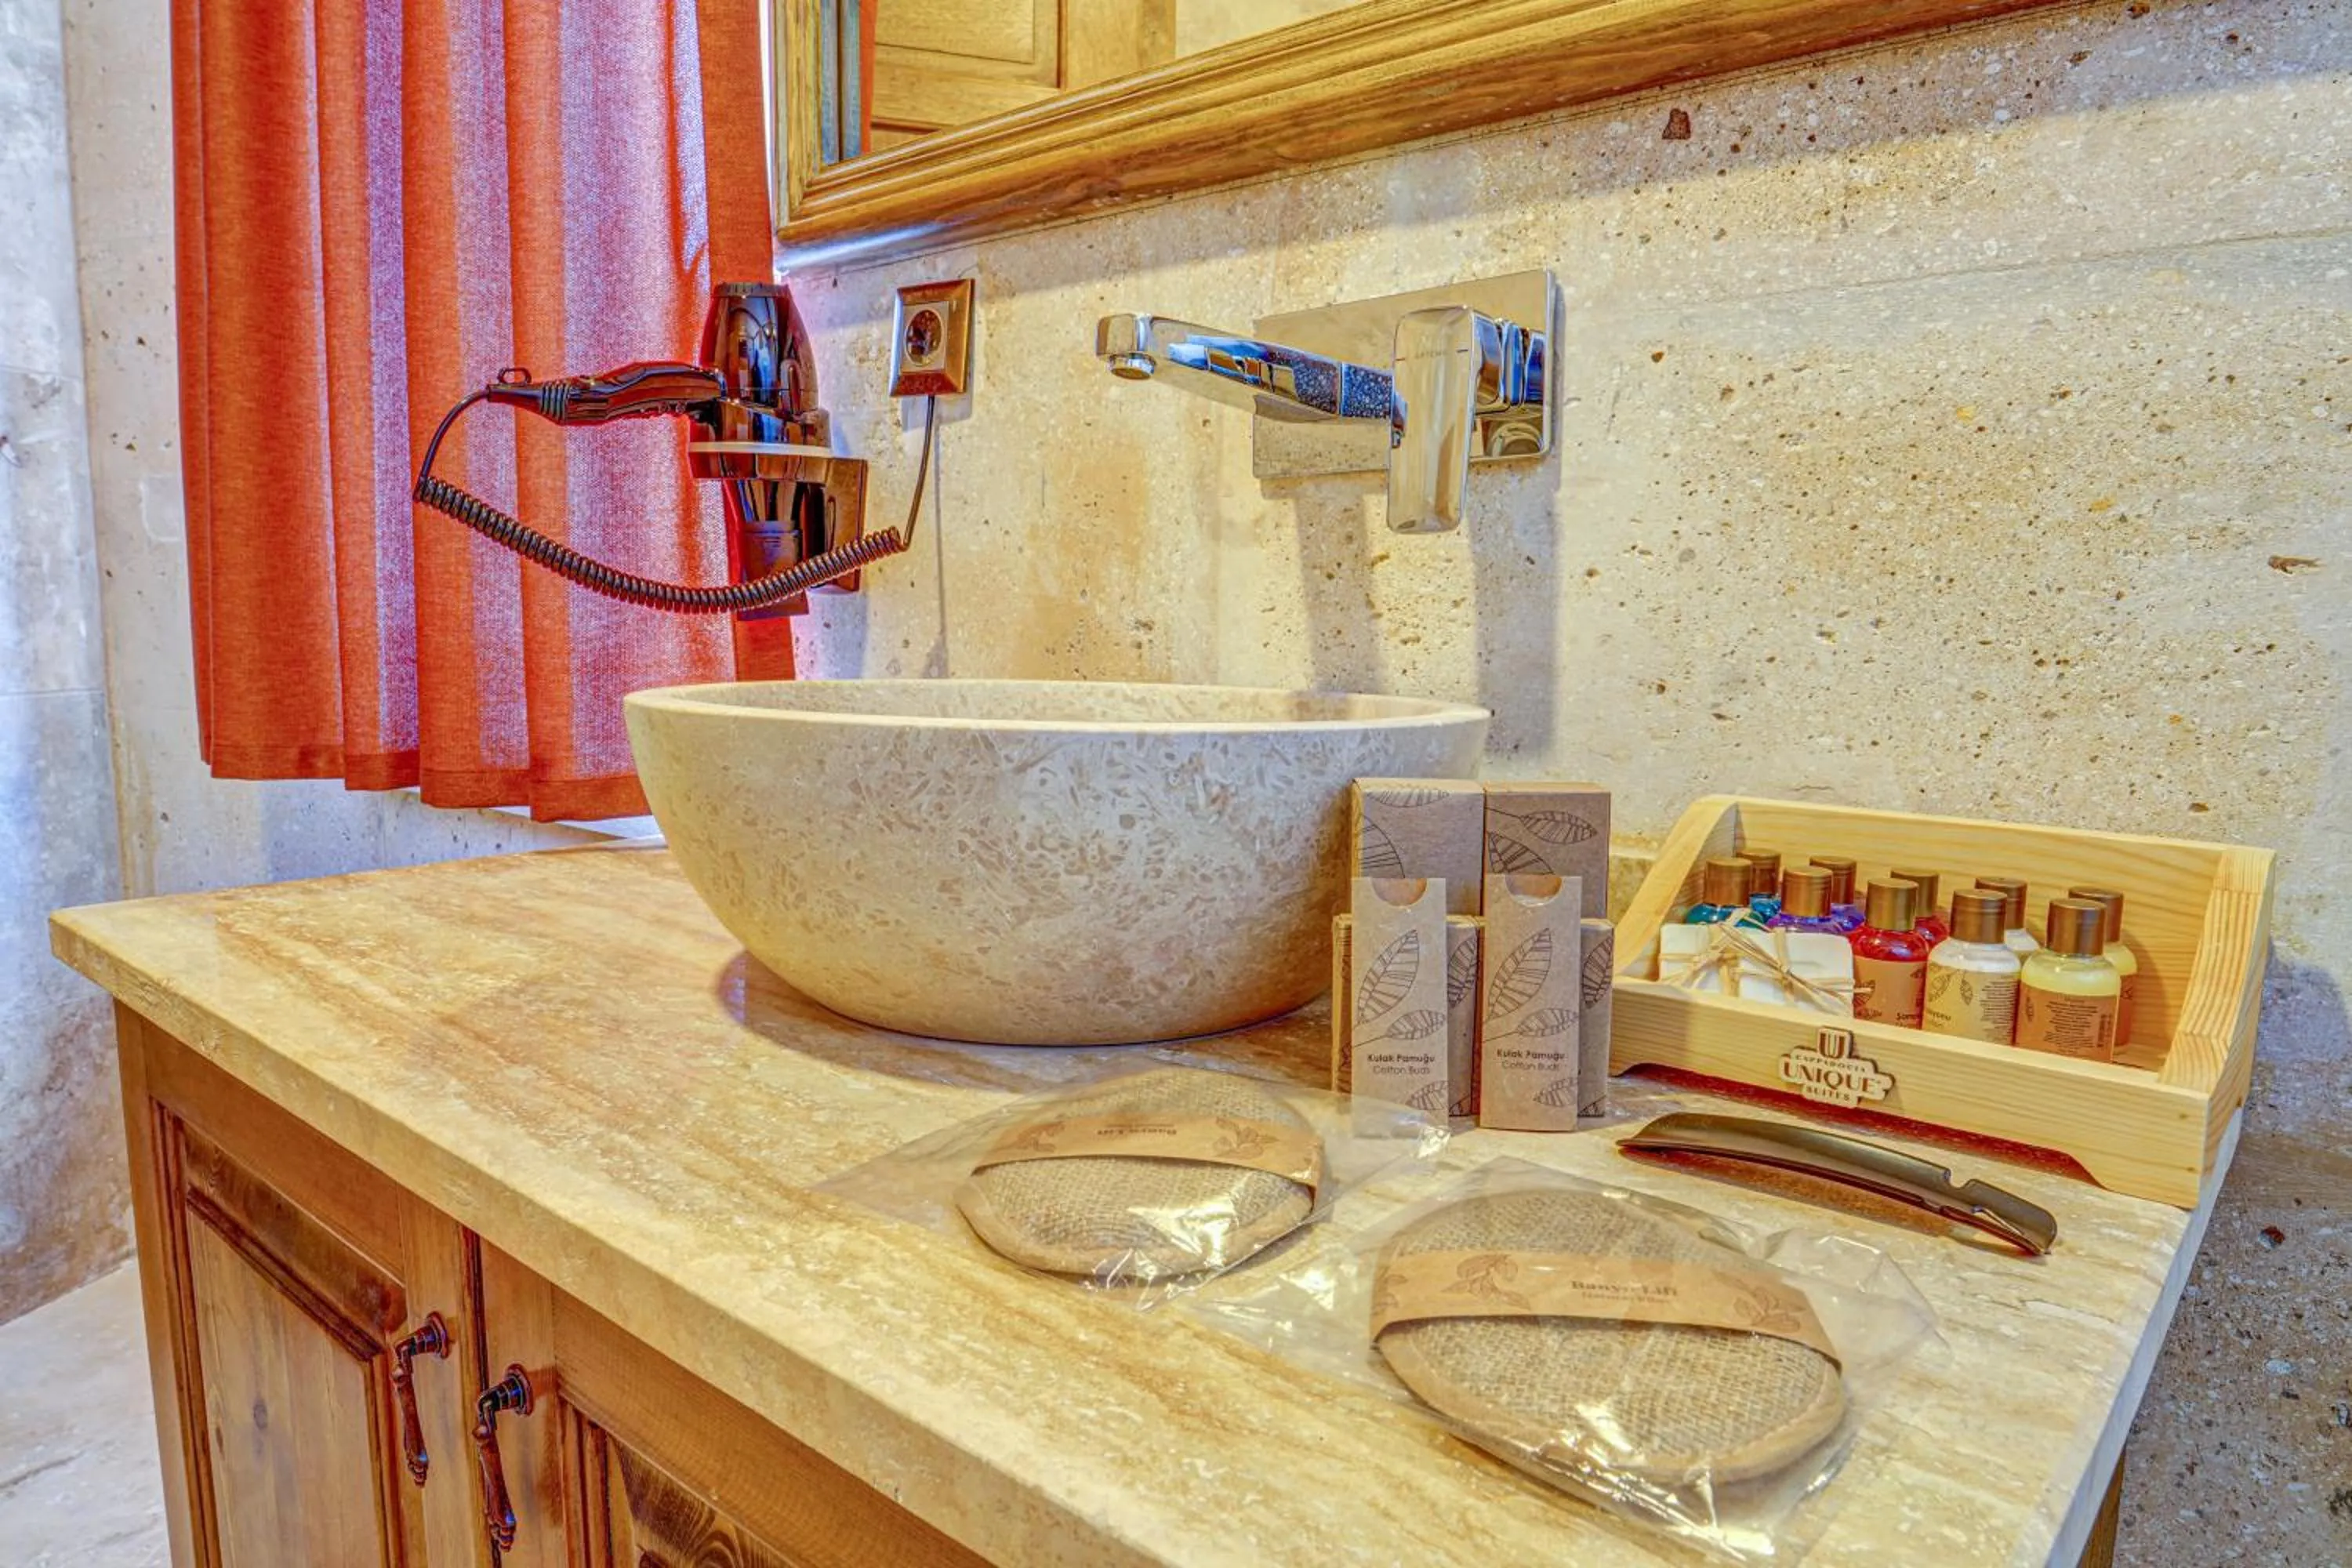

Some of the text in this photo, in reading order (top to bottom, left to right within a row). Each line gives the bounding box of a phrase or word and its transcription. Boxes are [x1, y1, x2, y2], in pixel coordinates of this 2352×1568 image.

[1795, 1054, 1866, 1073] CAPPADOCIA
[1784, 1060, 1879, 1094] UNIQUE
[1806, 1085, 1851, 1102] SUITES
